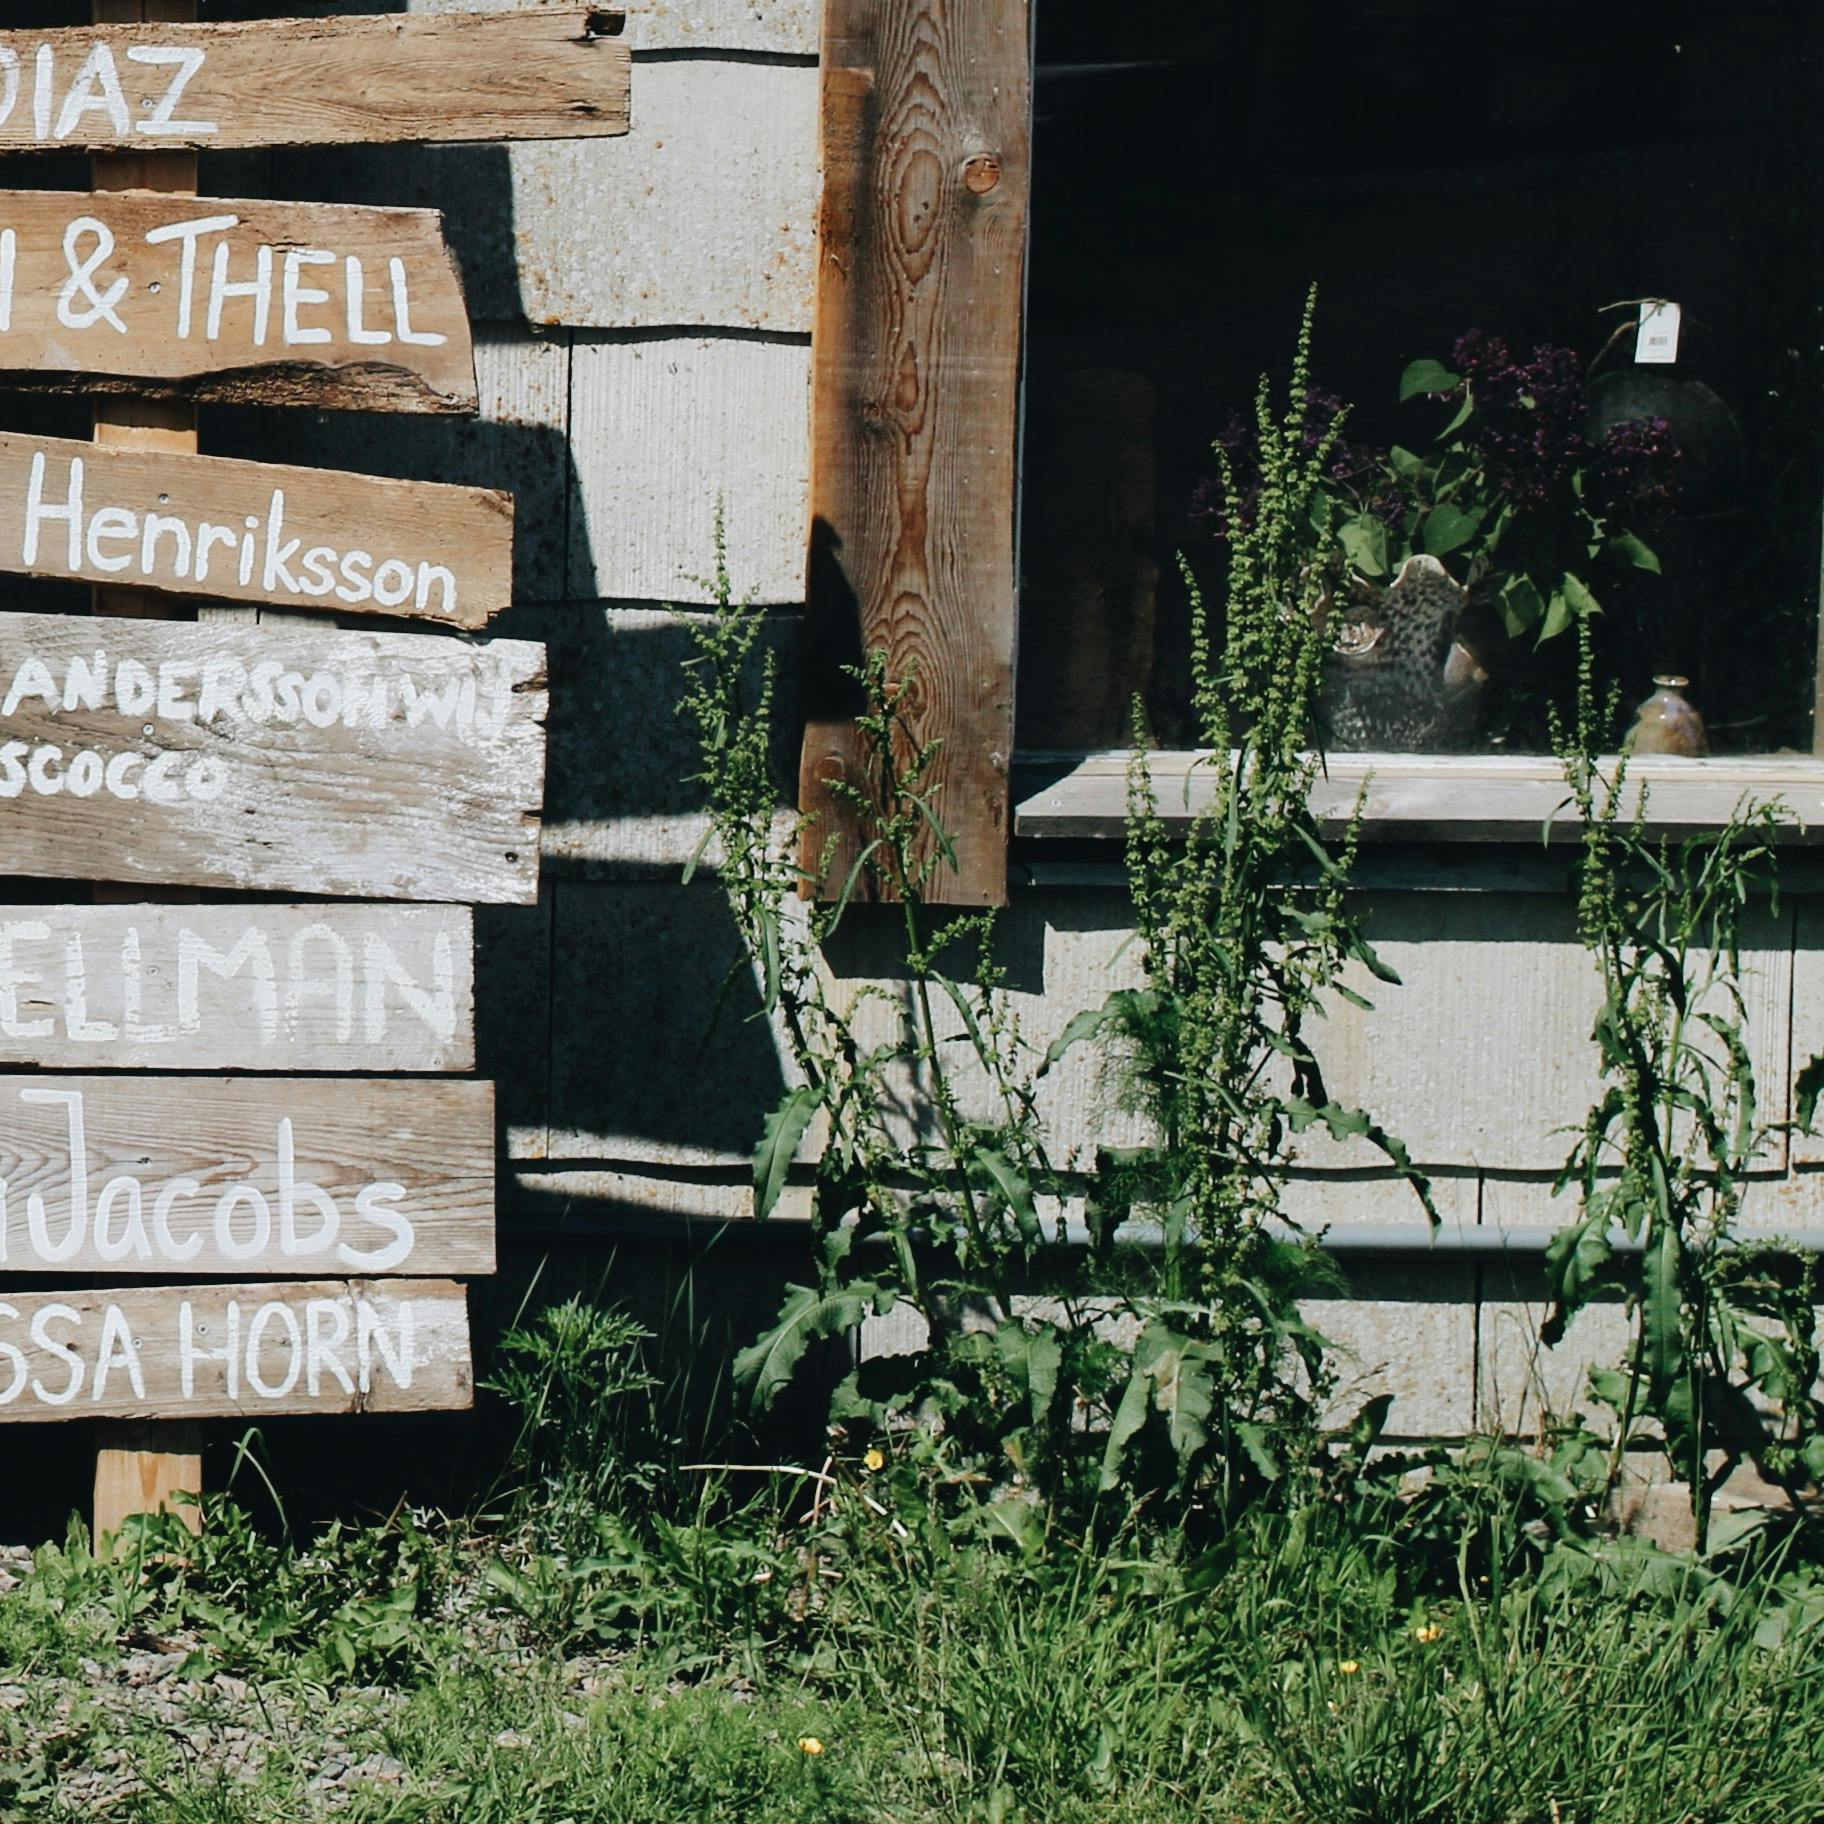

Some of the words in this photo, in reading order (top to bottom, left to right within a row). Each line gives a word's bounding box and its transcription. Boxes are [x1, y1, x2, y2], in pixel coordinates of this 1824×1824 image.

[56, 216, 131, 334] &
[145, 214, 448, 348] THELL
[23, 450, 458, 614] Henriksson
[21, 1088, 417, 1271] Jacobs
[181, 1299, 415, 1398] HORN
